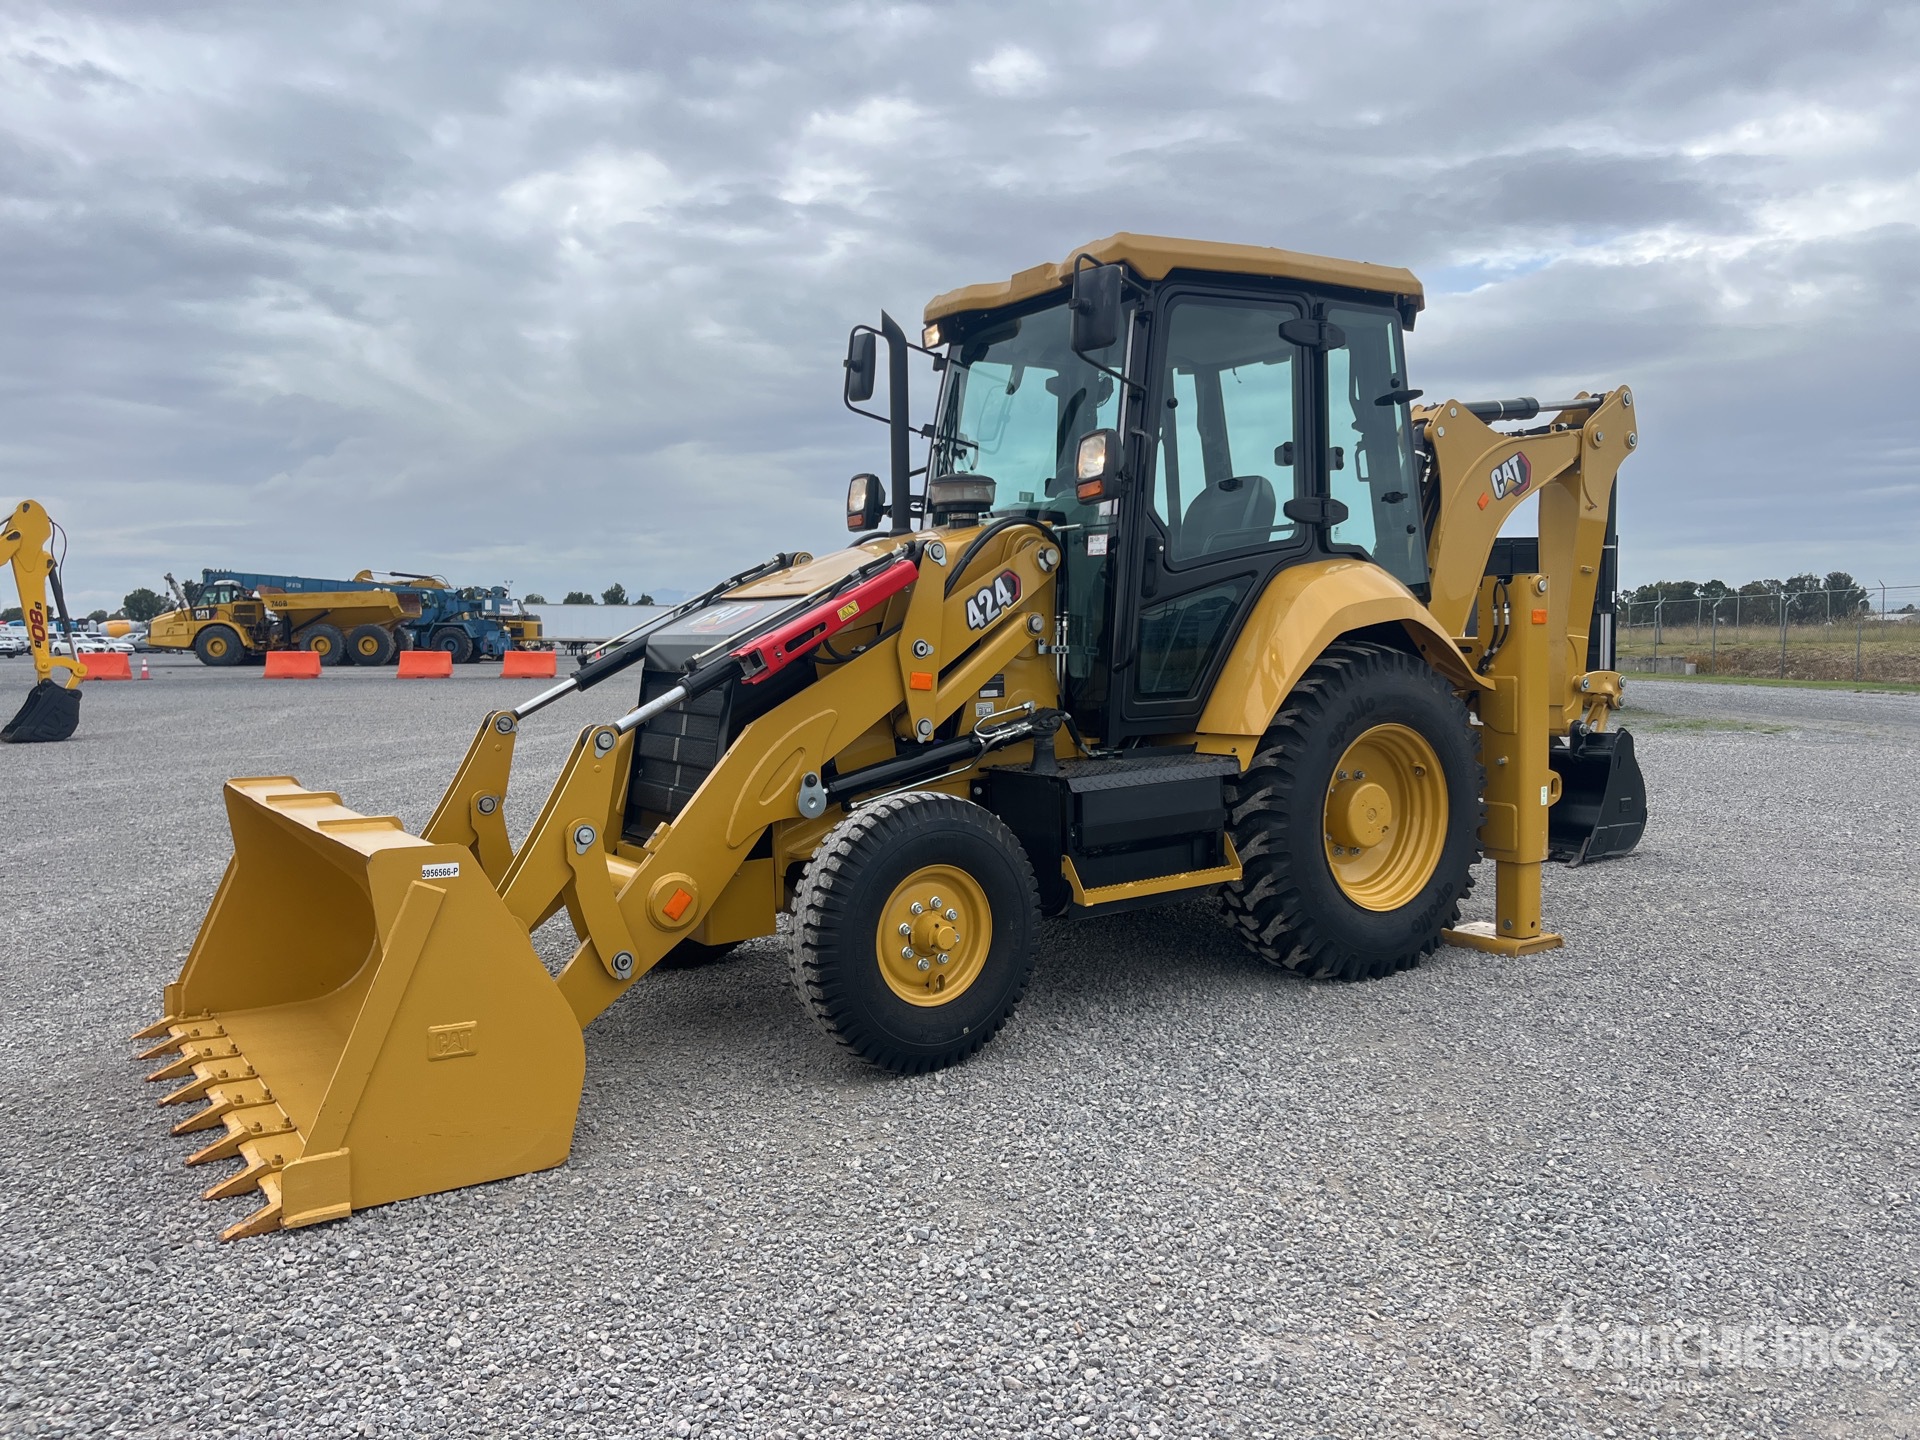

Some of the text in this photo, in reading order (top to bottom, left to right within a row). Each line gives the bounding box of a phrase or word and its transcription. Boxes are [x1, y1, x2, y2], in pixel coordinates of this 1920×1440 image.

[1490, 454, 1522, 499] CAT
[195, 609, 210, 620] CAT
[967, 576, 1013, 628] 424
[1326, 695, 1376, 750] apollo
[422, 867, 459, 878] 5956566-P
[1411, 882, 1454, 935] apollo
[436, 1029, 472, 1056] CAT
